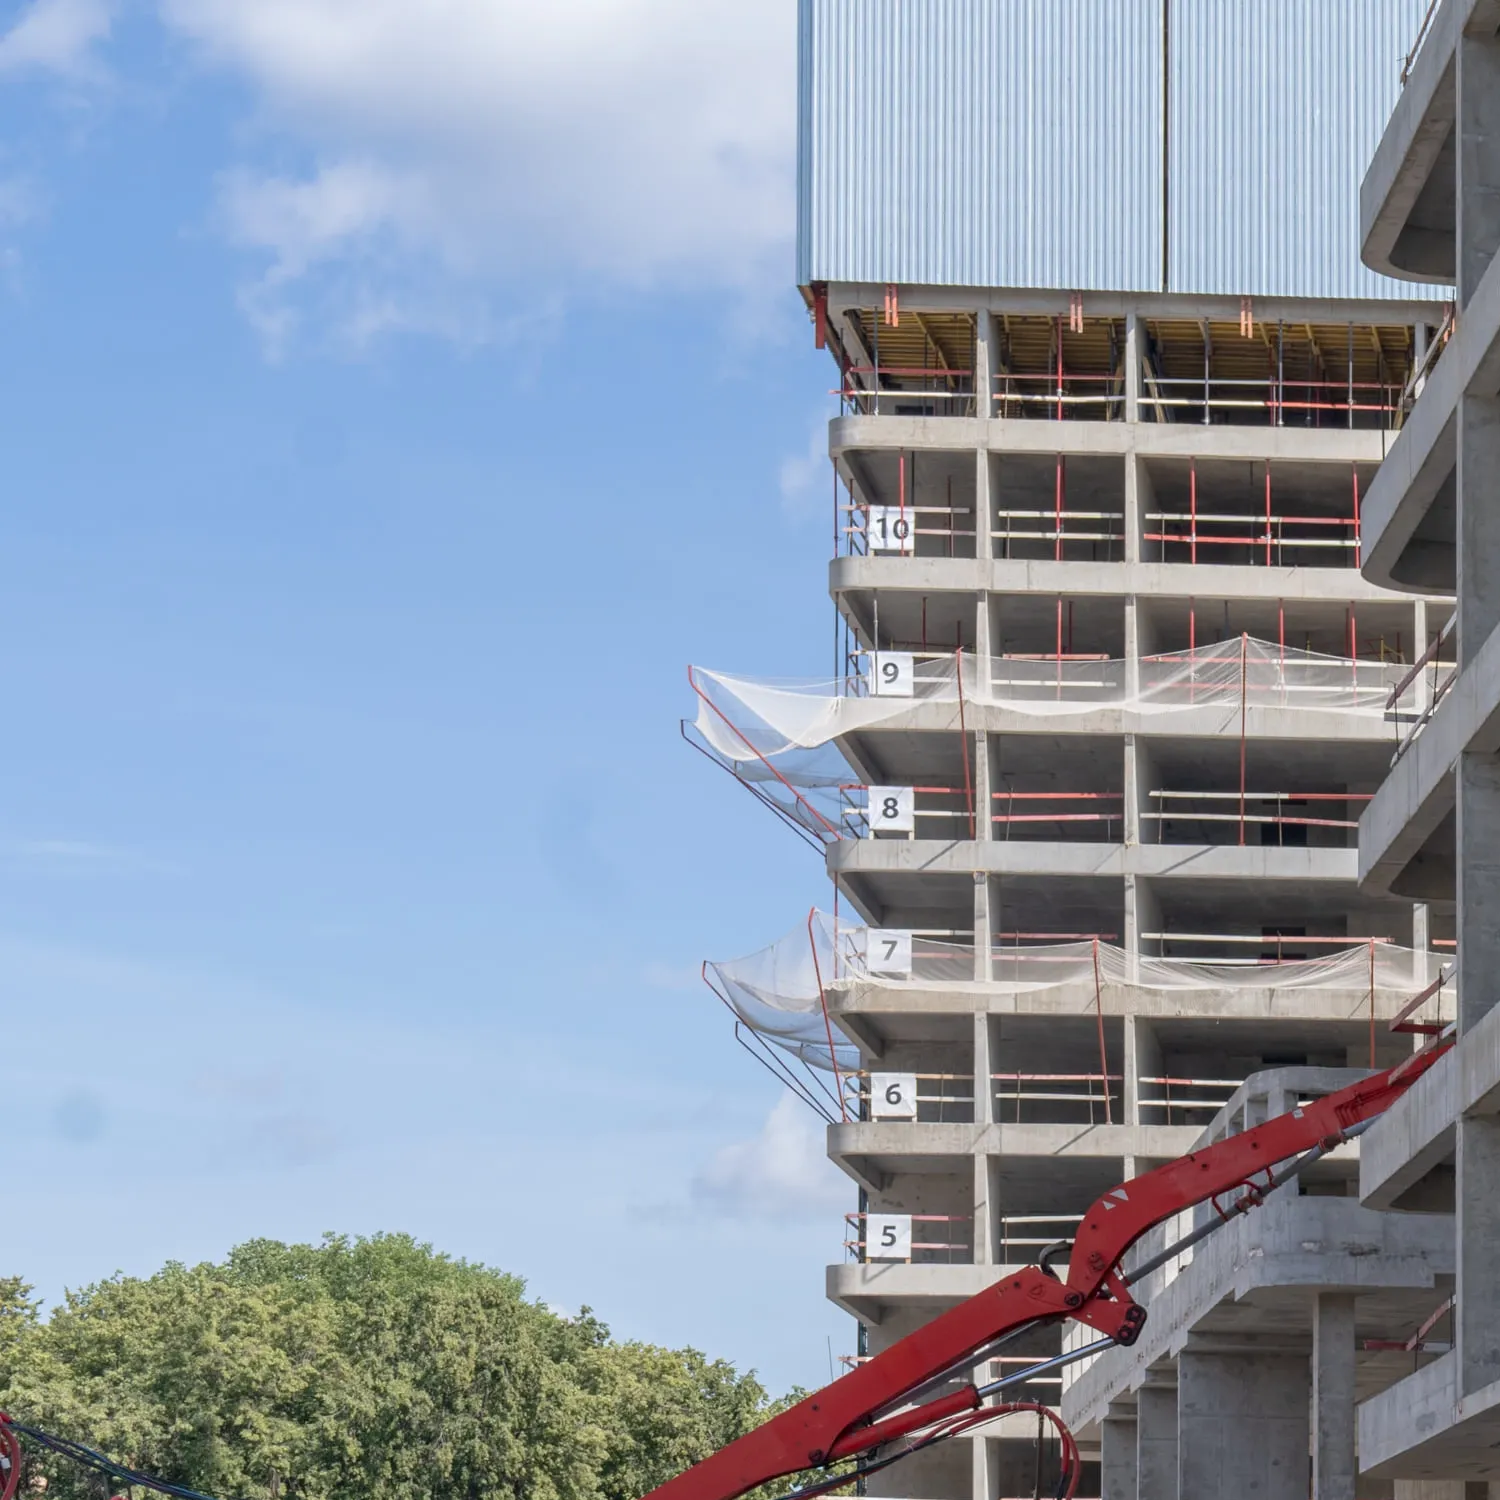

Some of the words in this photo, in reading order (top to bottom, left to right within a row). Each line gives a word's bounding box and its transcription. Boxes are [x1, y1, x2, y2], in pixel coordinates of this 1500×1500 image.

[876, 517, 909, 540] 10
[882, 662, 899, 684] 9
[882, 797, 899, 819] 8
[882, 940, 898, 960] 7
[885, 1083, 902, 1105] 6
[881, 1225, 897, 1247] 5
